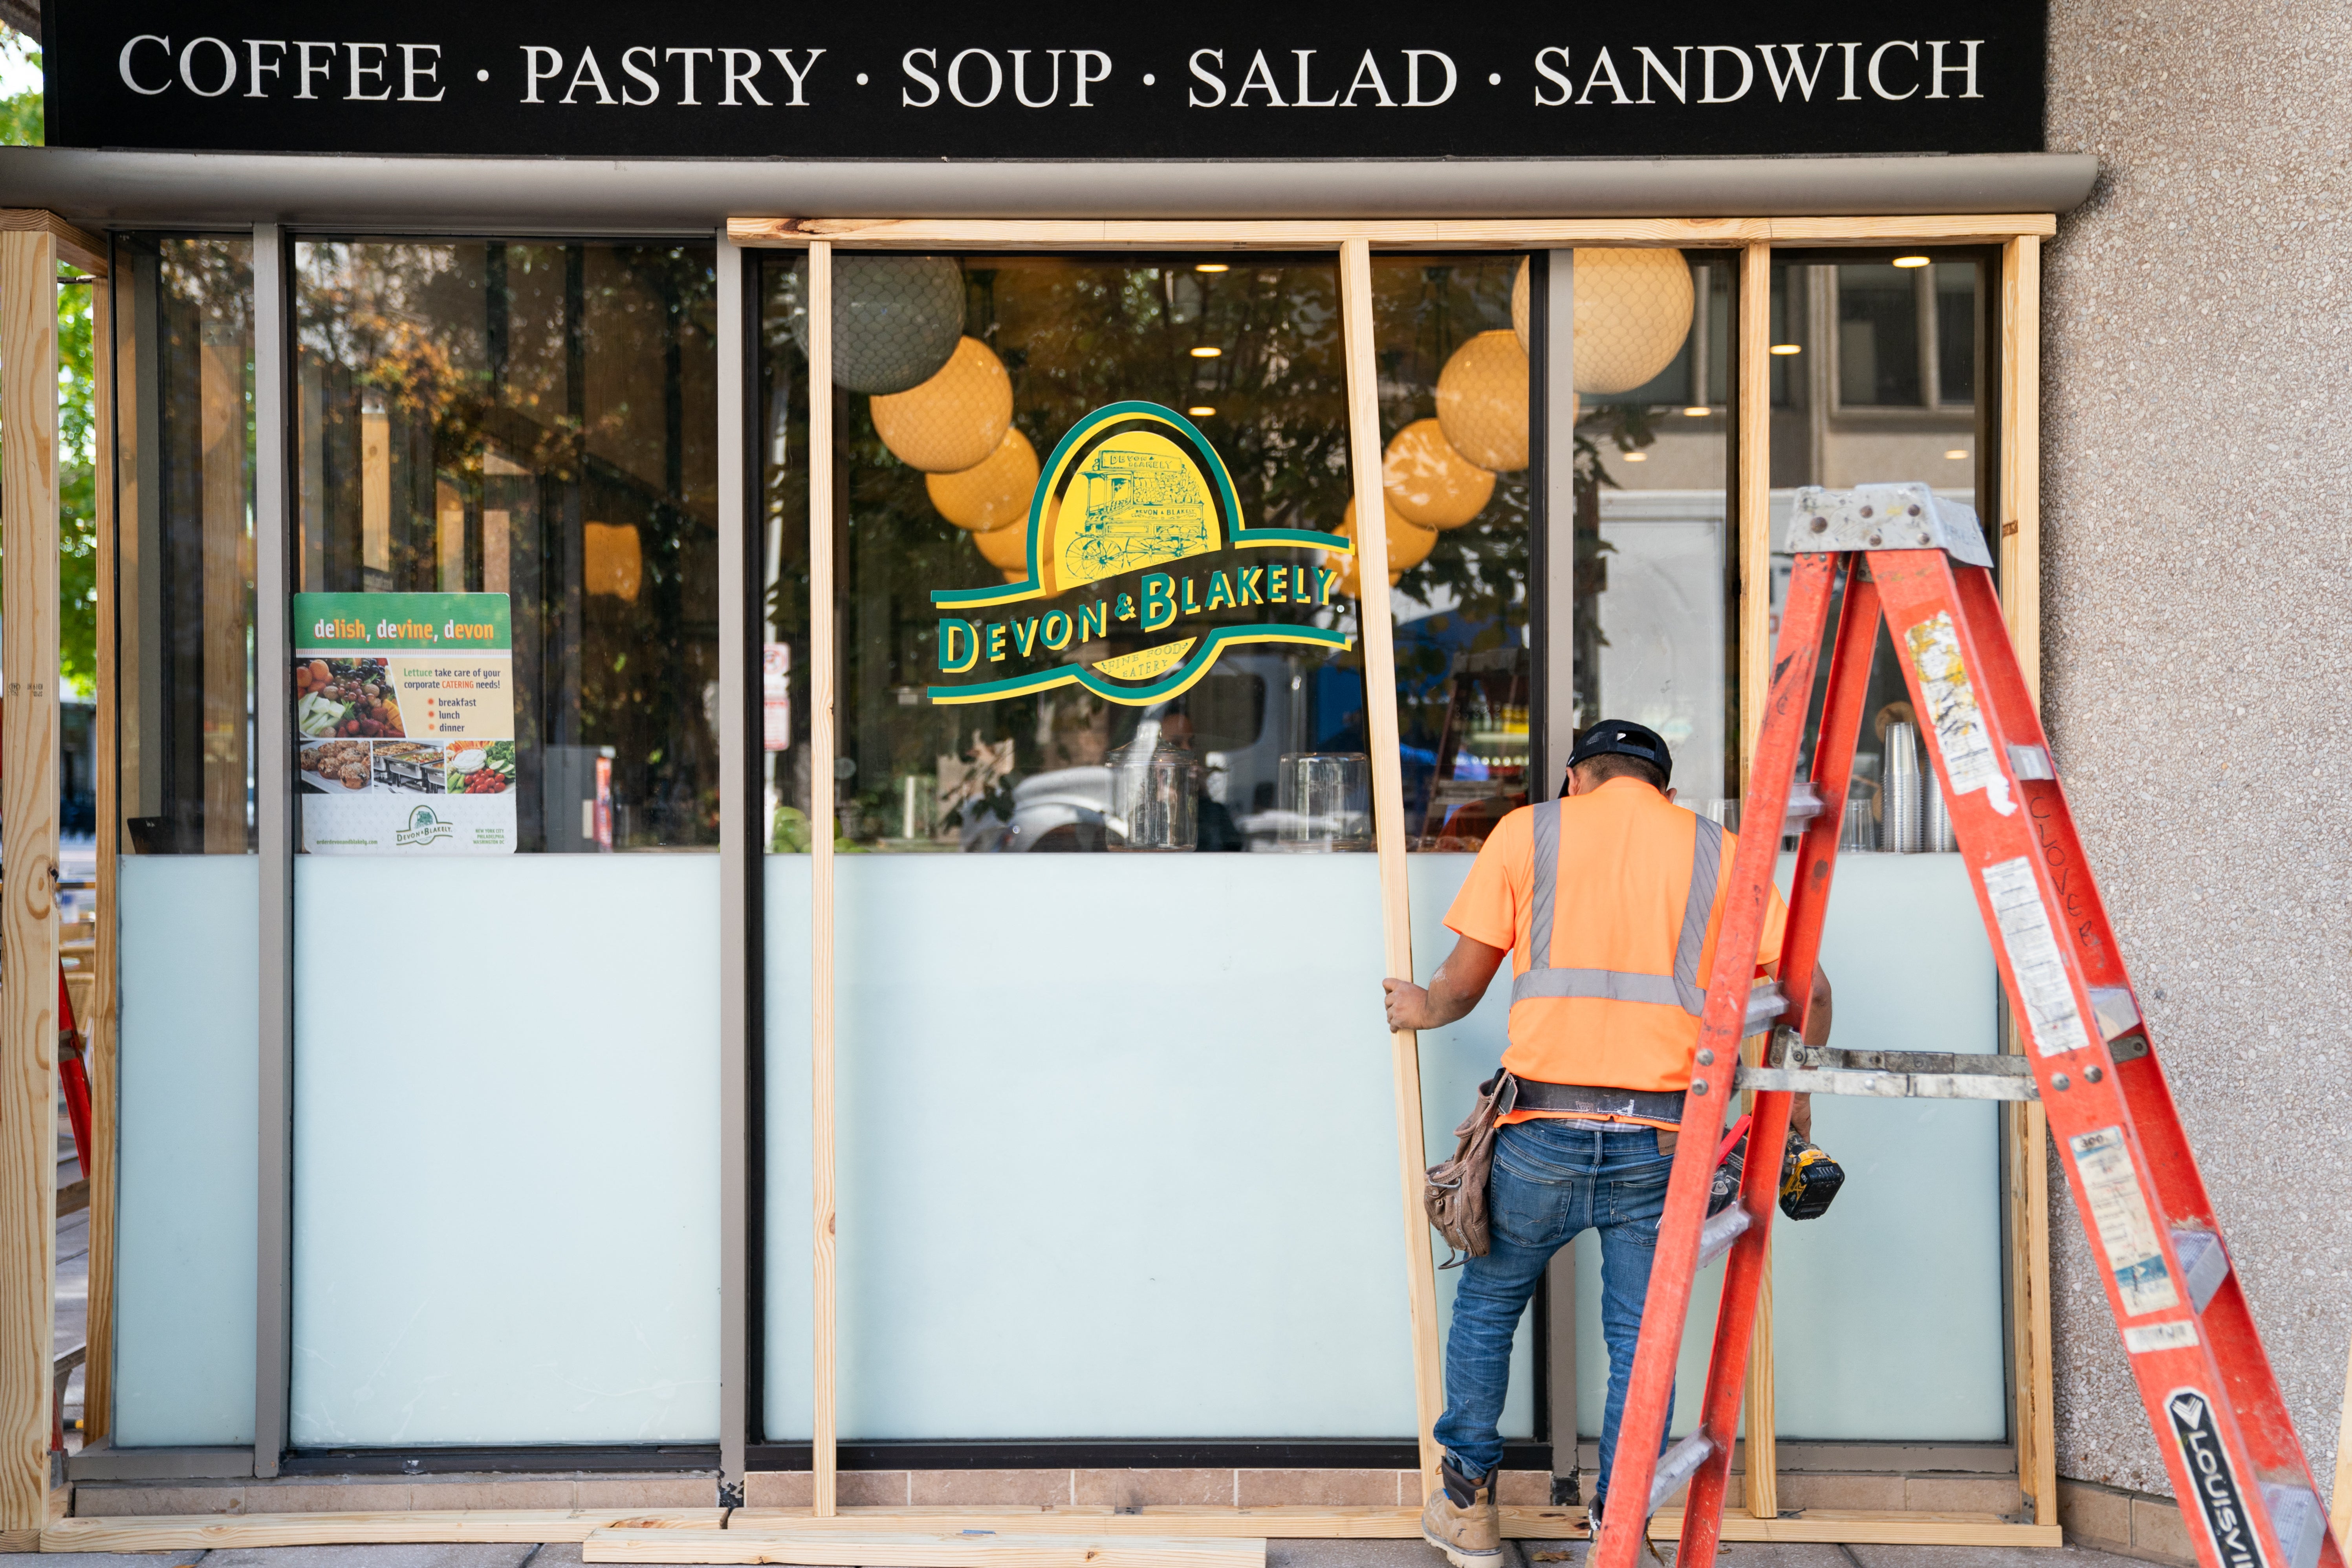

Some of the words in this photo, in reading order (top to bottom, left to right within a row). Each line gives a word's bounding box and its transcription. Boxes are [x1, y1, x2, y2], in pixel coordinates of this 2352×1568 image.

[119, 35, 445, 101] COFFEE
[519, 46, 826, 106] PASTRY
[902, 48, 1112, 108] SOUP
[1189, 48, 1457, 107] SALAD
[1535, 40, 1985, 106] SANDWICH
[939, 599, 1106, 673] DEVON
[1114, 593, 1137, 621] &
[1140, 565, 1337, 633] BLAKELY
[314, 619, 371, 642] delish,
[376, 619, 438, 643] devine,
[444, 619, 494, 640] devon
[1108, 654, 1139, 674] FINE
[1147, 643, 1181, 658] FOOD
[404, 668, 432, 677] Lettuce
[435, 668, 452, 677] take
[473, 668, 482, 677] of
[484, 670, 501, 679] your
[1122, 659, 1168, 677] EATERY
[404, 680, 440, 691] corporate
[442, 680, 474, 689] CATERING
[476, 680, 500, 689] needs!
[438, 698, 476, 707] breakfast
[439, 711, 460, 719] lunch
[440, 723, 465, 732] dinner
[397, 832, 420, 842] DEVON
[424, 826, 451, 835] BLAKELY
[2187, 1429, 2255, 1568] LOUISVI
